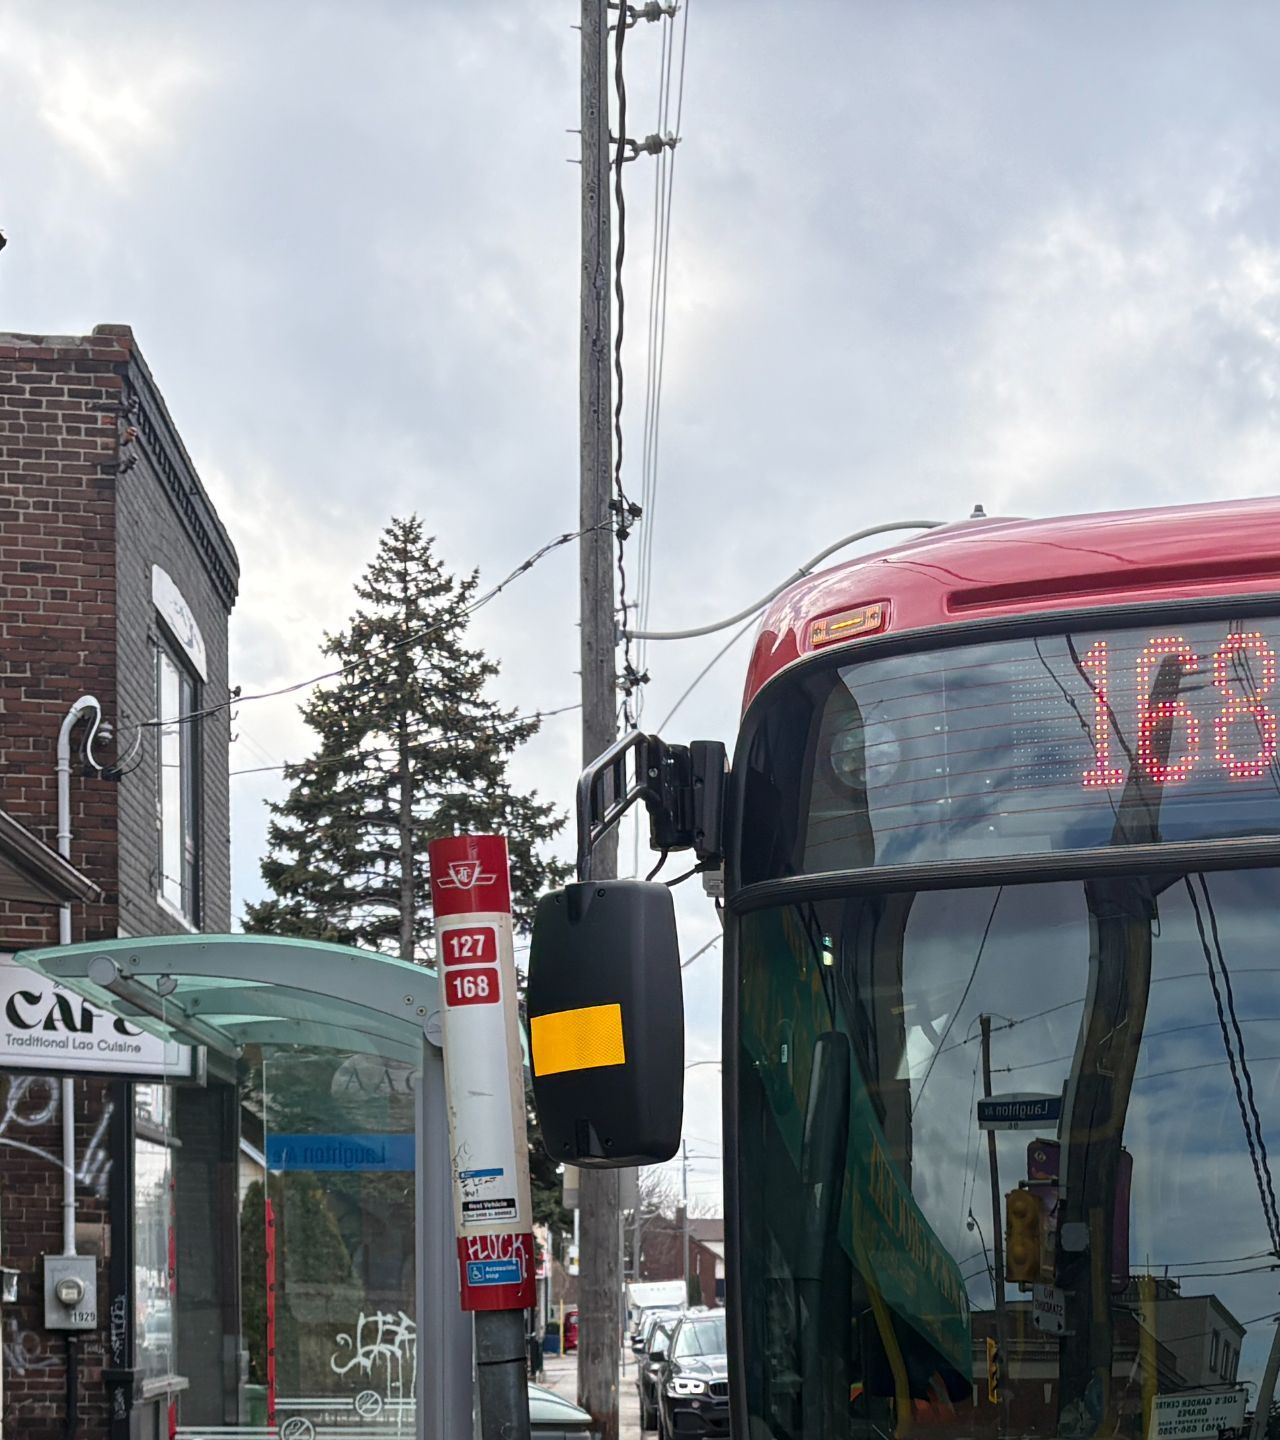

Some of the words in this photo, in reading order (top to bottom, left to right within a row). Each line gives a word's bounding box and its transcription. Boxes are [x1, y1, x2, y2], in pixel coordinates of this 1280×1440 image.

[1081, 631, 1277, 786] 168
[450, 934, 484, 959] 127
[452, 974, 489, 999] 168
[6, 1033, 69, 1050] Traditional
[73, 1037, 94, 1051] Lao
[97, 1040, 141, 1053] Cuisine
